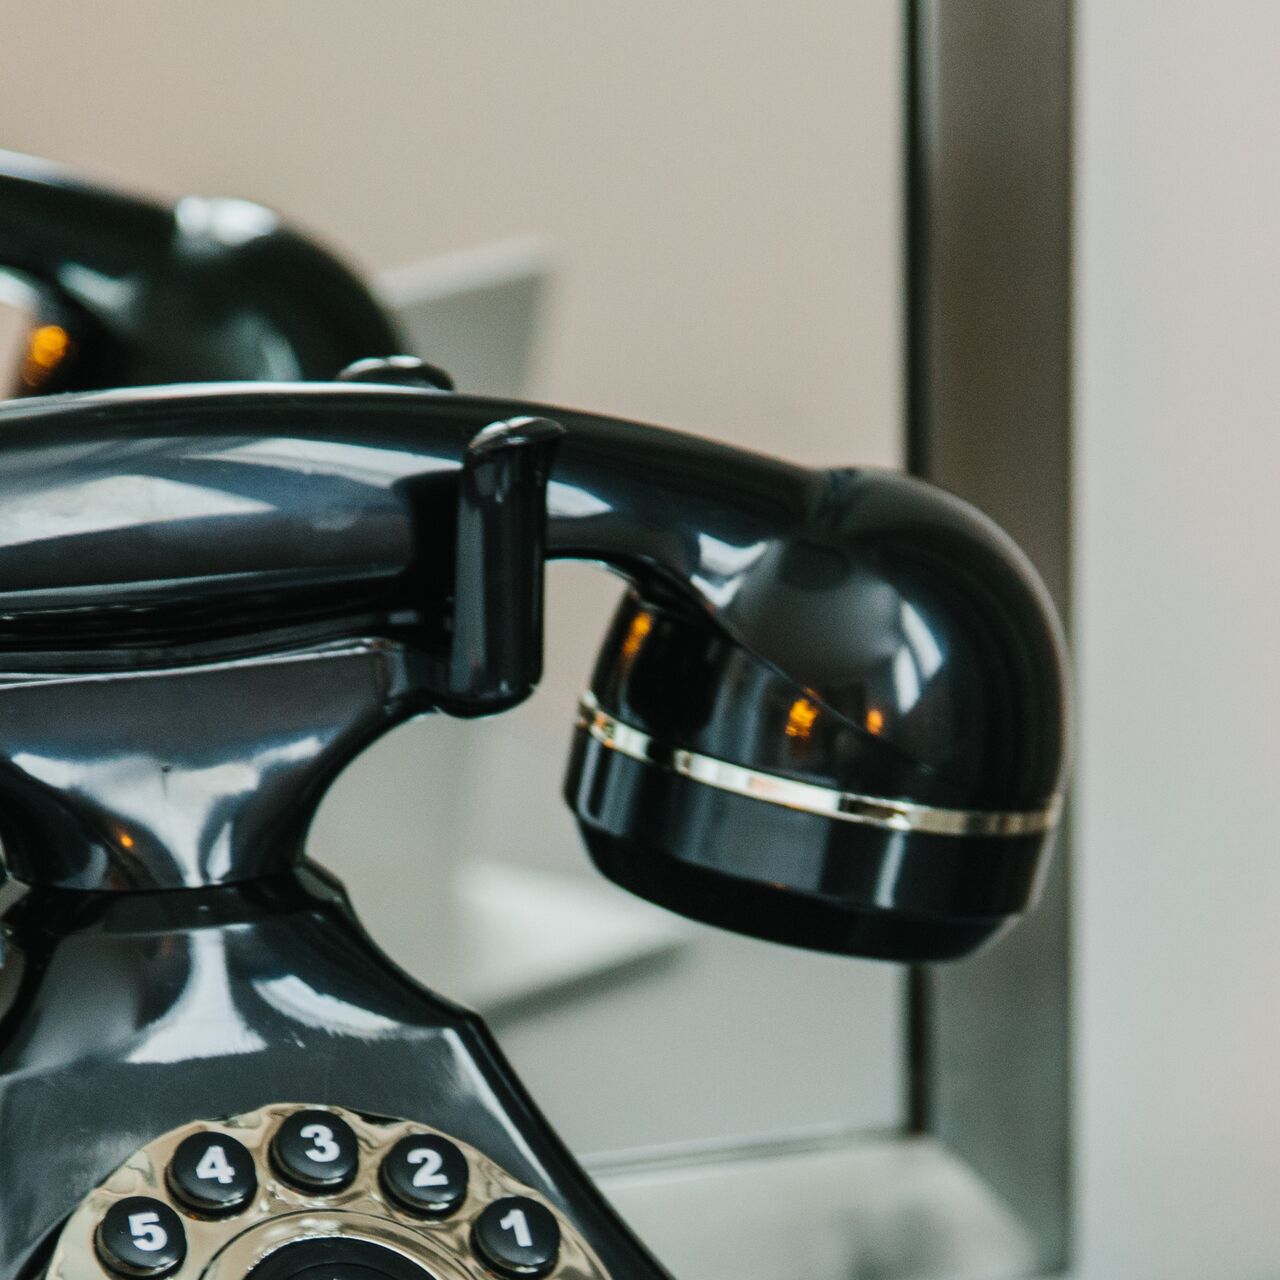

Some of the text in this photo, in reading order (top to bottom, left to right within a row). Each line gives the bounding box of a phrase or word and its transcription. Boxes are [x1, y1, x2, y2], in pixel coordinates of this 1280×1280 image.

[300, 1124, 340, 1163] 3
[195, 1145, 236, 1184] 4
[409, 1148, 449, 1187] 2
[128, 1212, 168, 1252] 5
[500, 1209, 532, 1247] 1
